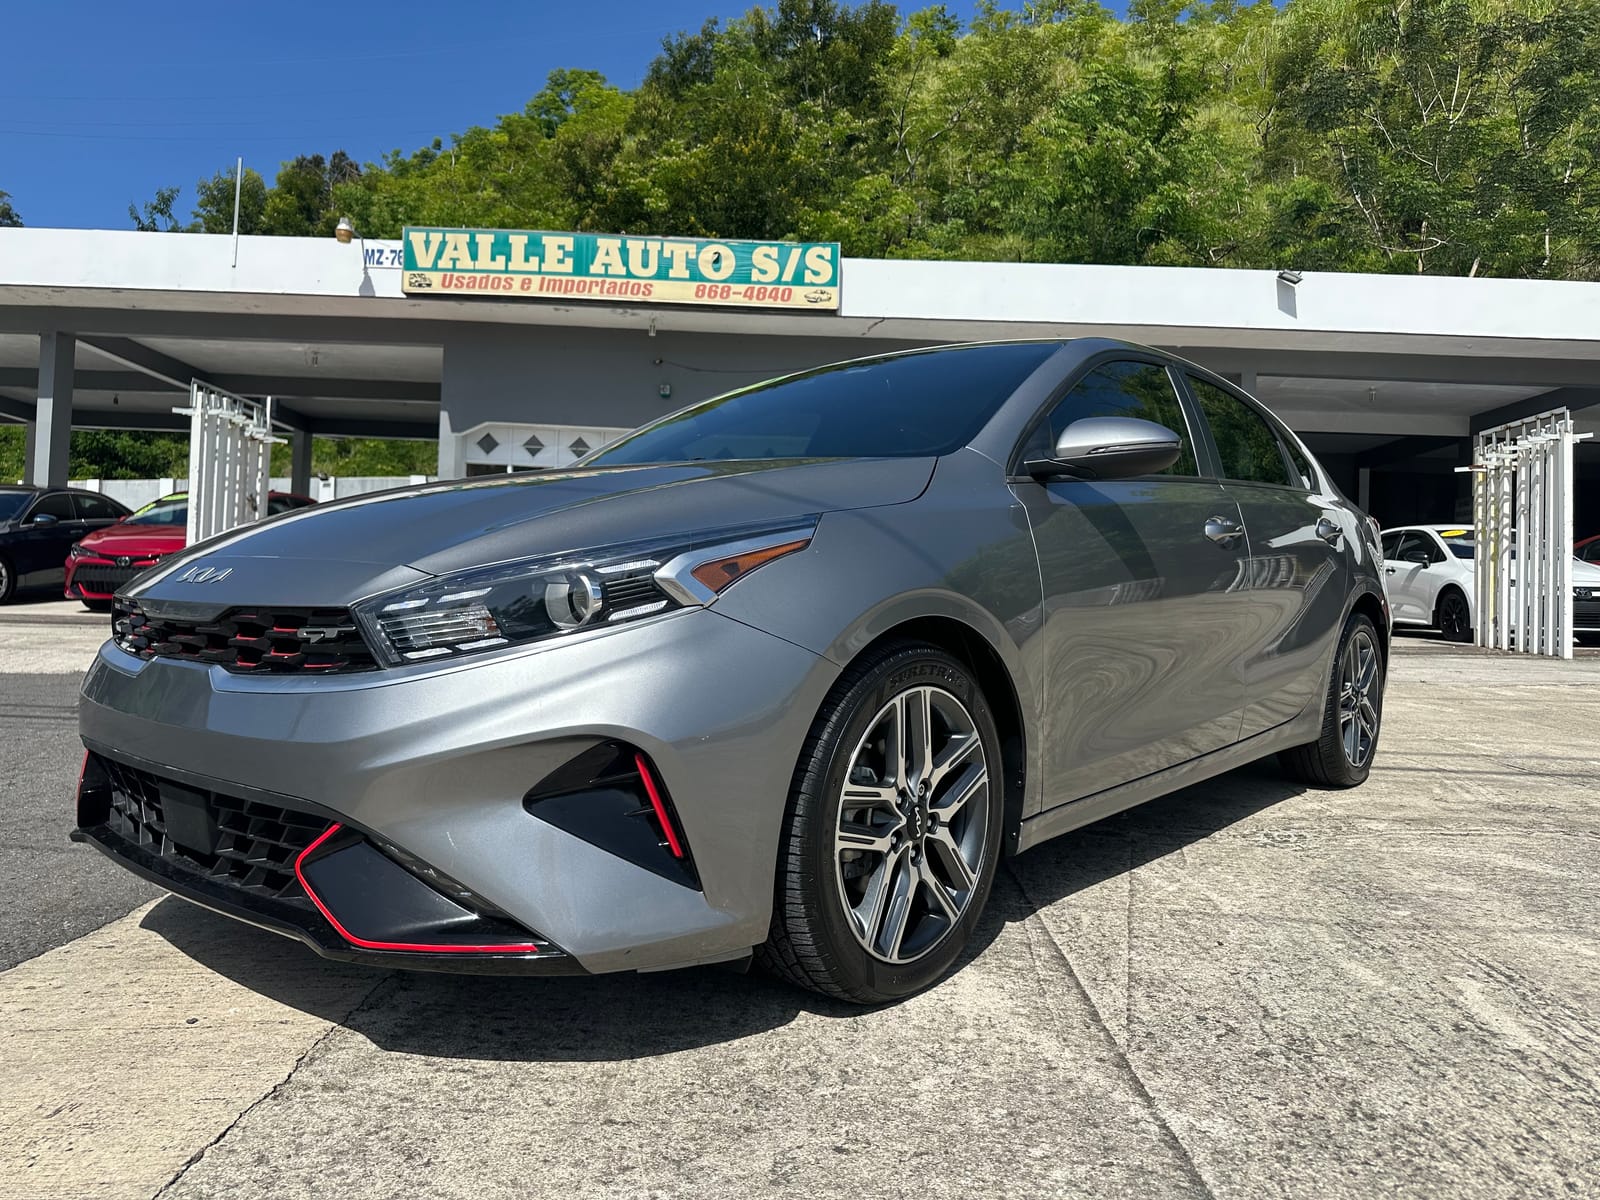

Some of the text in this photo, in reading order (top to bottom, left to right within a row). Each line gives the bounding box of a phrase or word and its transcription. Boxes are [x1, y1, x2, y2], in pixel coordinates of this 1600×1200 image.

[409, 231, 833, 285] VALLE AUTO S/S
[441, 273, 653, 298] Usados e Importados
[695, 284, 793, 303] 868-4840
